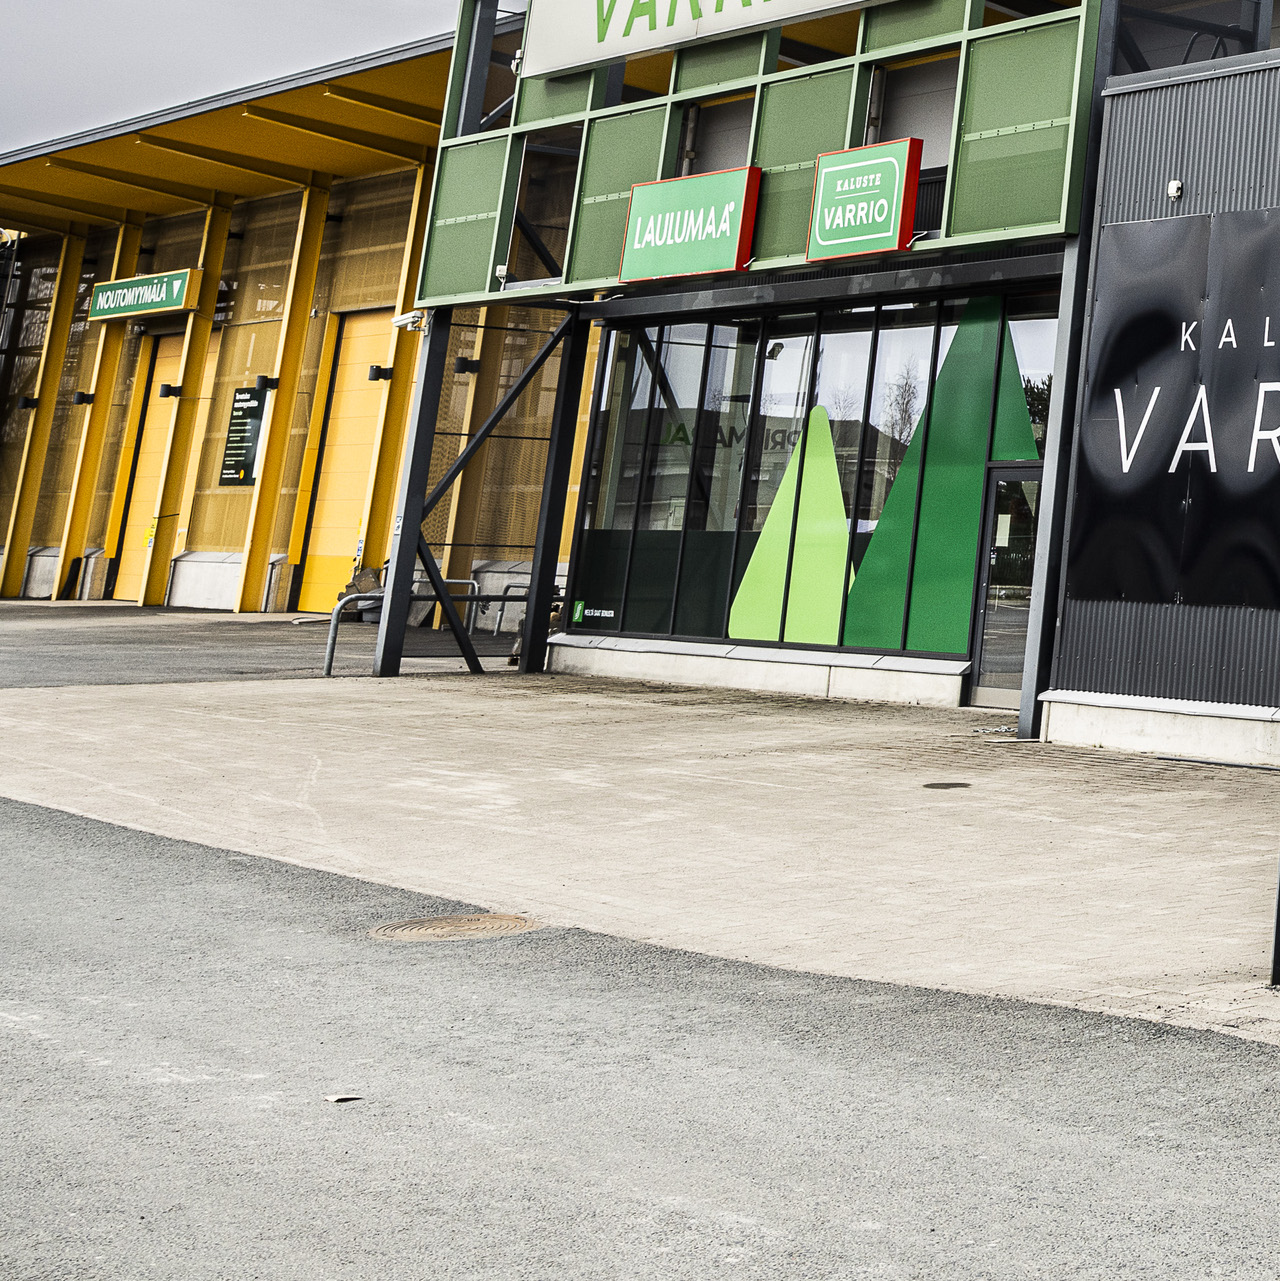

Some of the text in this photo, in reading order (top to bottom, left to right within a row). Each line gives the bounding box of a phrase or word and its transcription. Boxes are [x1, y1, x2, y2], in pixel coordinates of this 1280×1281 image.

[836, 173, 882, 192] KALUSTE
[824, 198, 888, 230] VARRIO
[96, 278, 168, 310] NOUTOMYYMÄLÄ
